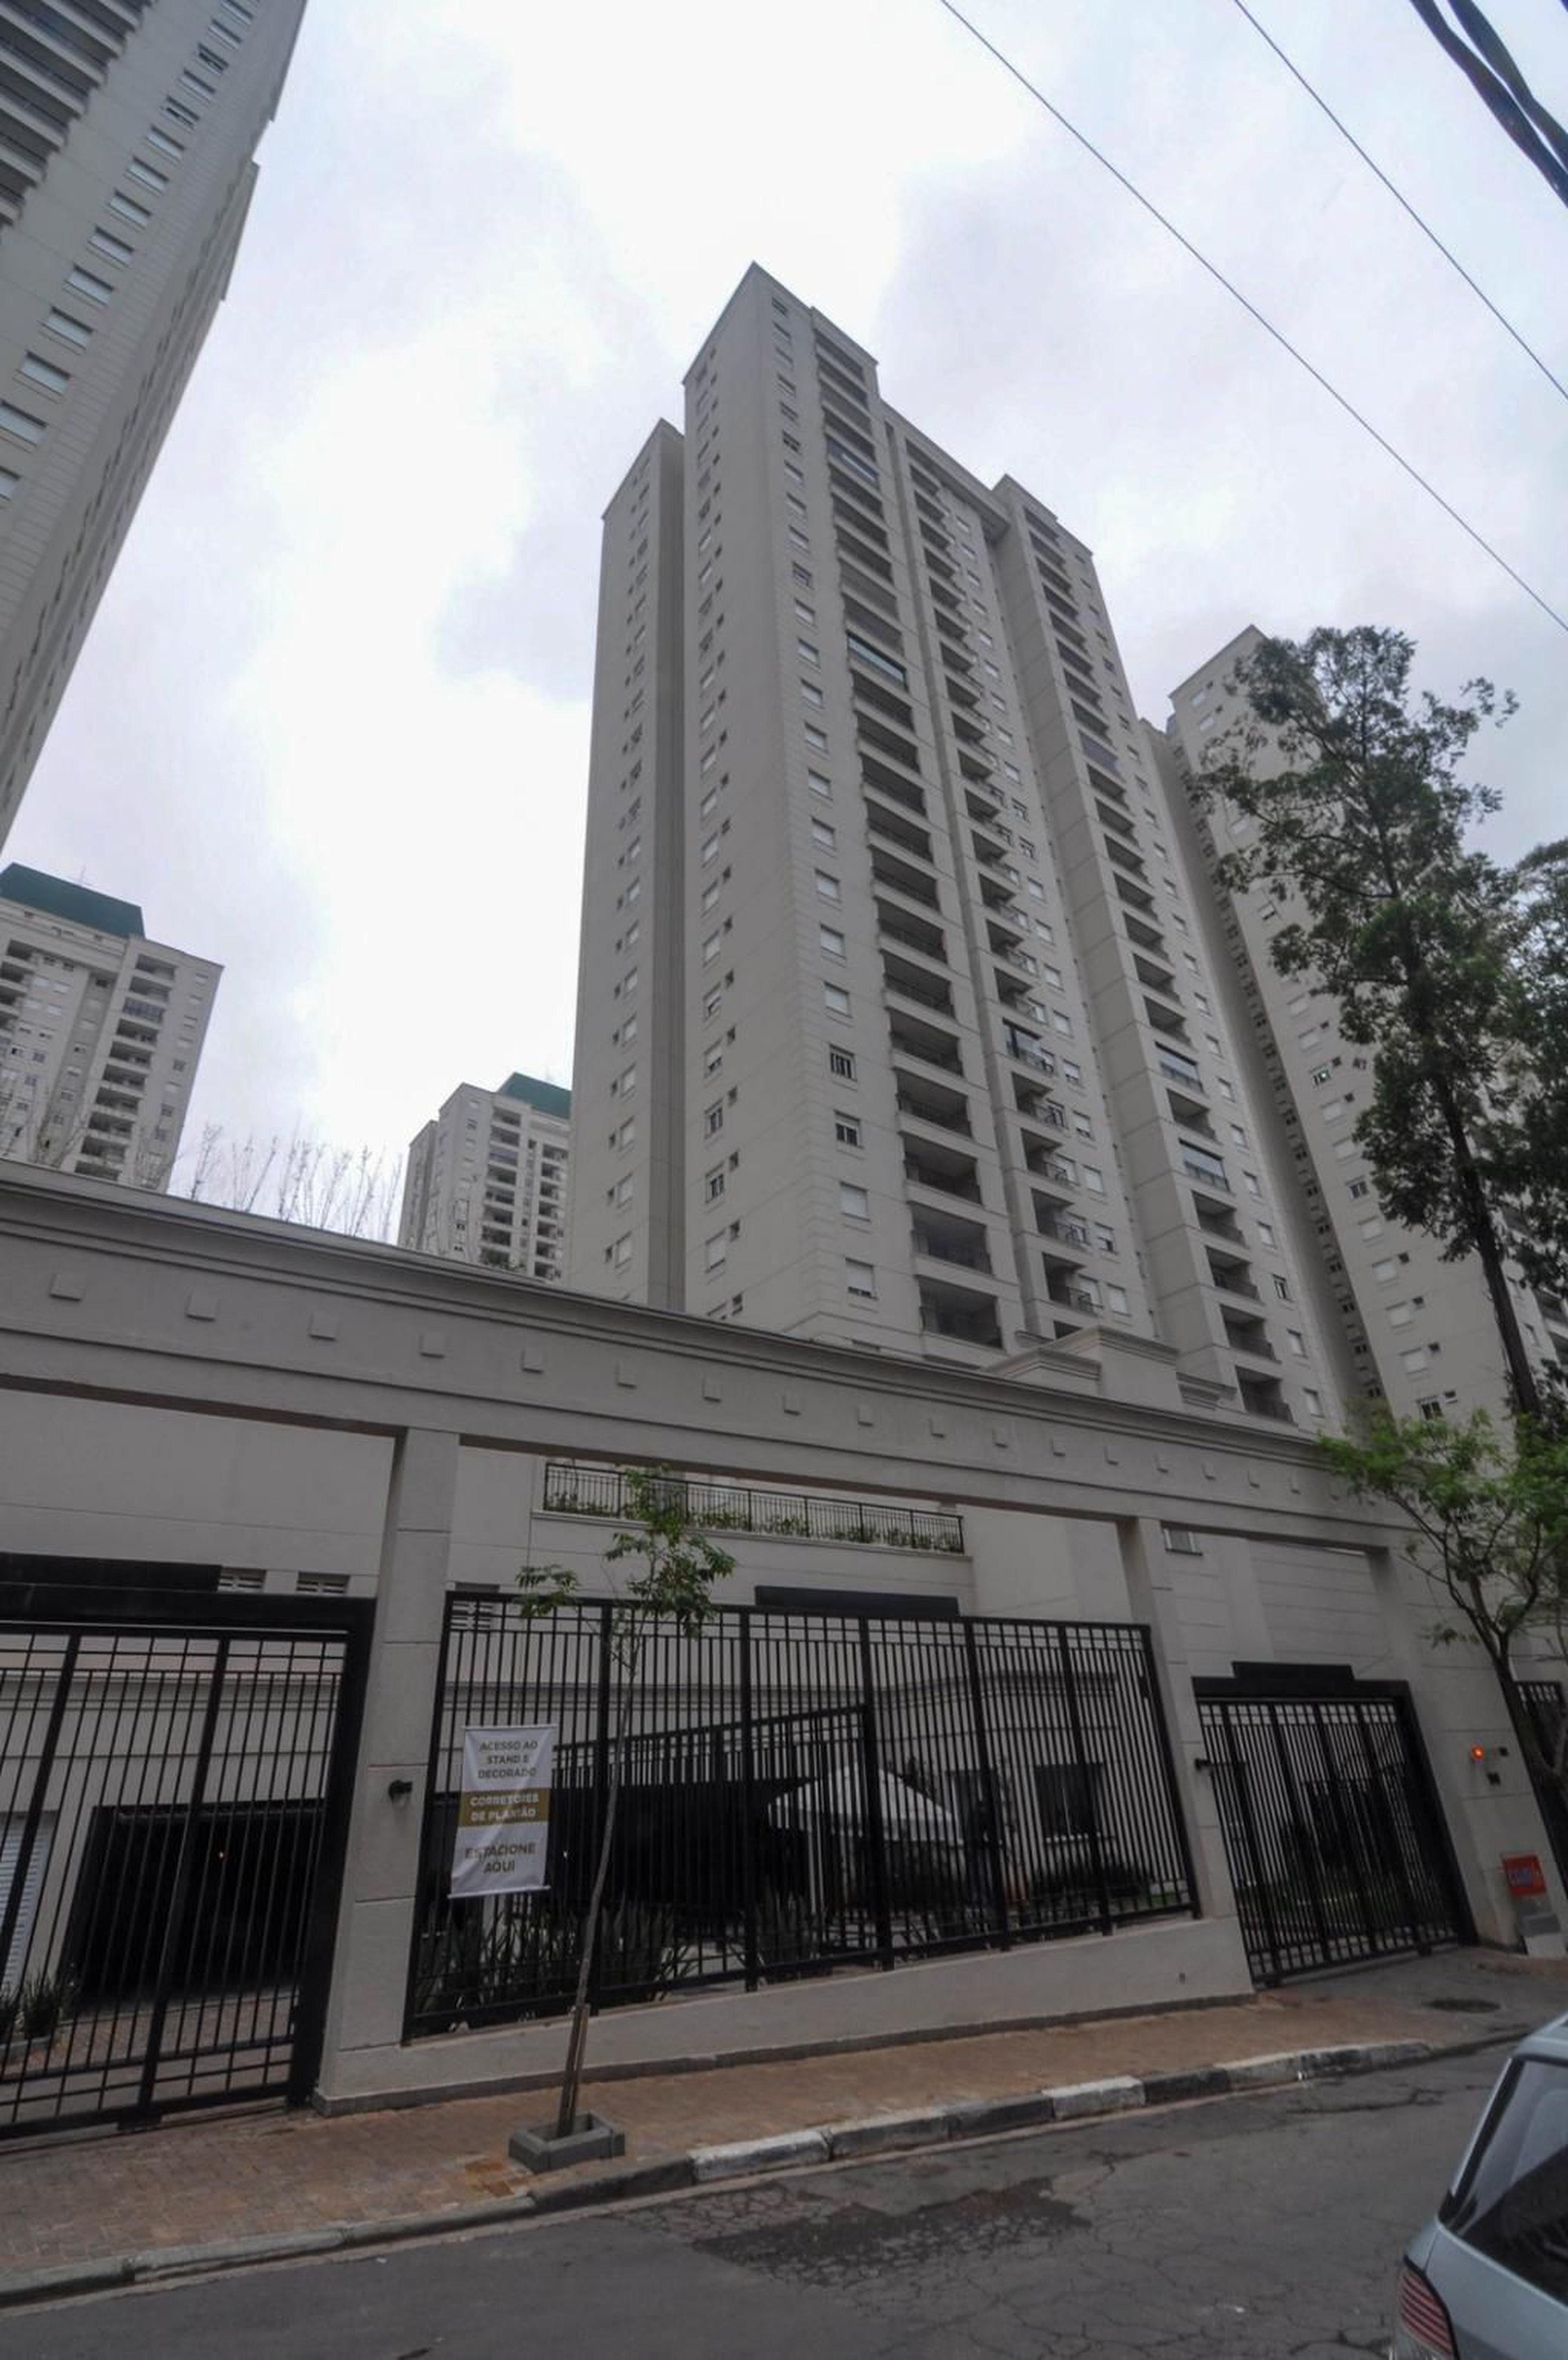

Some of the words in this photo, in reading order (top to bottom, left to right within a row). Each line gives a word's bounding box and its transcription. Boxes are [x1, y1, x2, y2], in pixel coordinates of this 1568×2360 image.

[479, 1741, 520, 1751] ACESSO
[523, 1740, 538, 1749] AO
[488, 1755, 521, 1764] STAND
[478, 1769, 537, 1779] DECORADO
[471, 1812, 485, 1821] DE
[466, 1843, 536, 1859] ESTACIONE
[484, 1861, 515, 1873] AQUI
